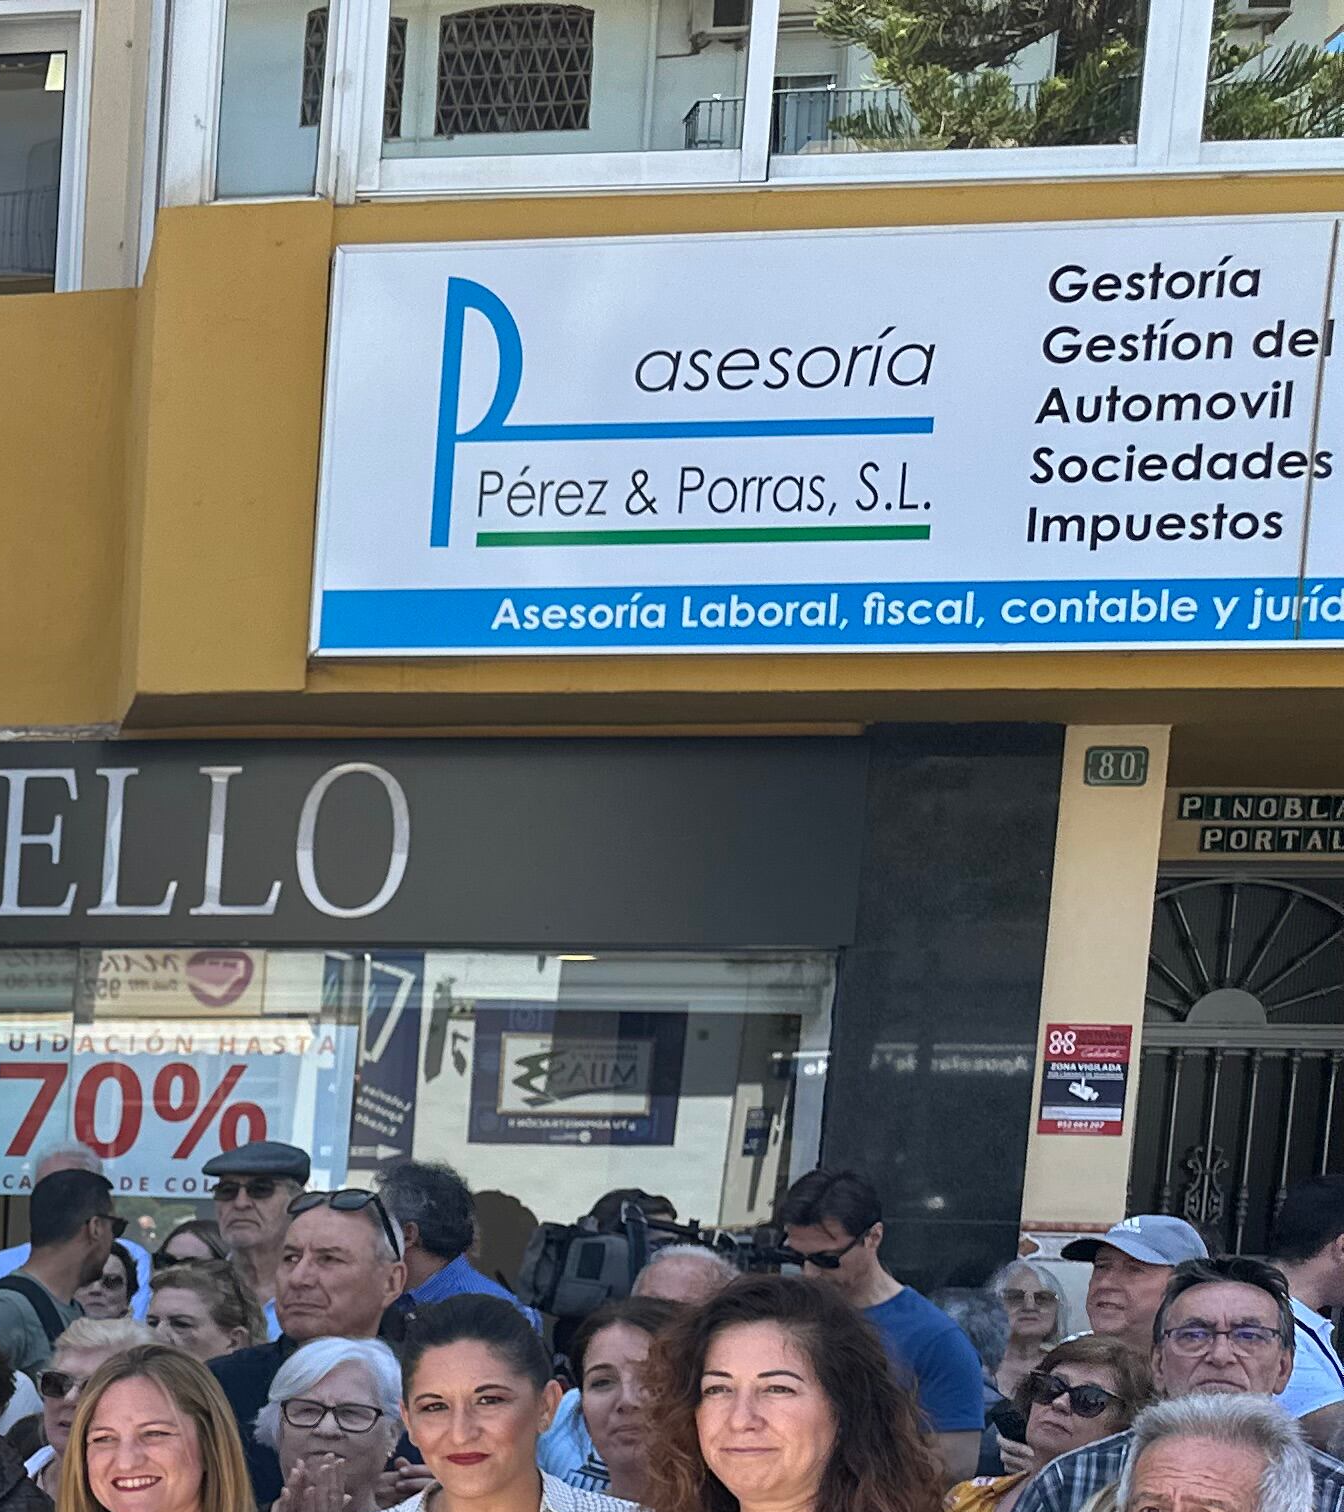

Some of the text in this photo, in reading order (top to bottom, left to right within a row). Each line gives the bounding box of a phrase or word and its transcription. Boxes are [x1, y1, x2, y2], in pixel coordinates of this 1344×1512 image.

[1048, 255, 1261, 303] Gestoría
[635, 326, 936, 392] asesoría
[1252, 319, 1335, 358] del
[1034, 380, 1294, 424] Automovil
[1029, 442, 1333, 484] Sociedades
[477, 461, 931, 518] Pérez & Porras, S.L.
[1027, 503, 1283, 551] Impuestos
[491, 593, 666, 631] Asesoría
[682, 592, 849, 631] Laboral,
[863, 590, 985, 629] fiscal,
[1000, 588, 1198, 624] contable
[1214, 595, 1240, 630] y
[1098, 751, 1136, 780] 80
[219, 1034, 337, 1056] HASTA
